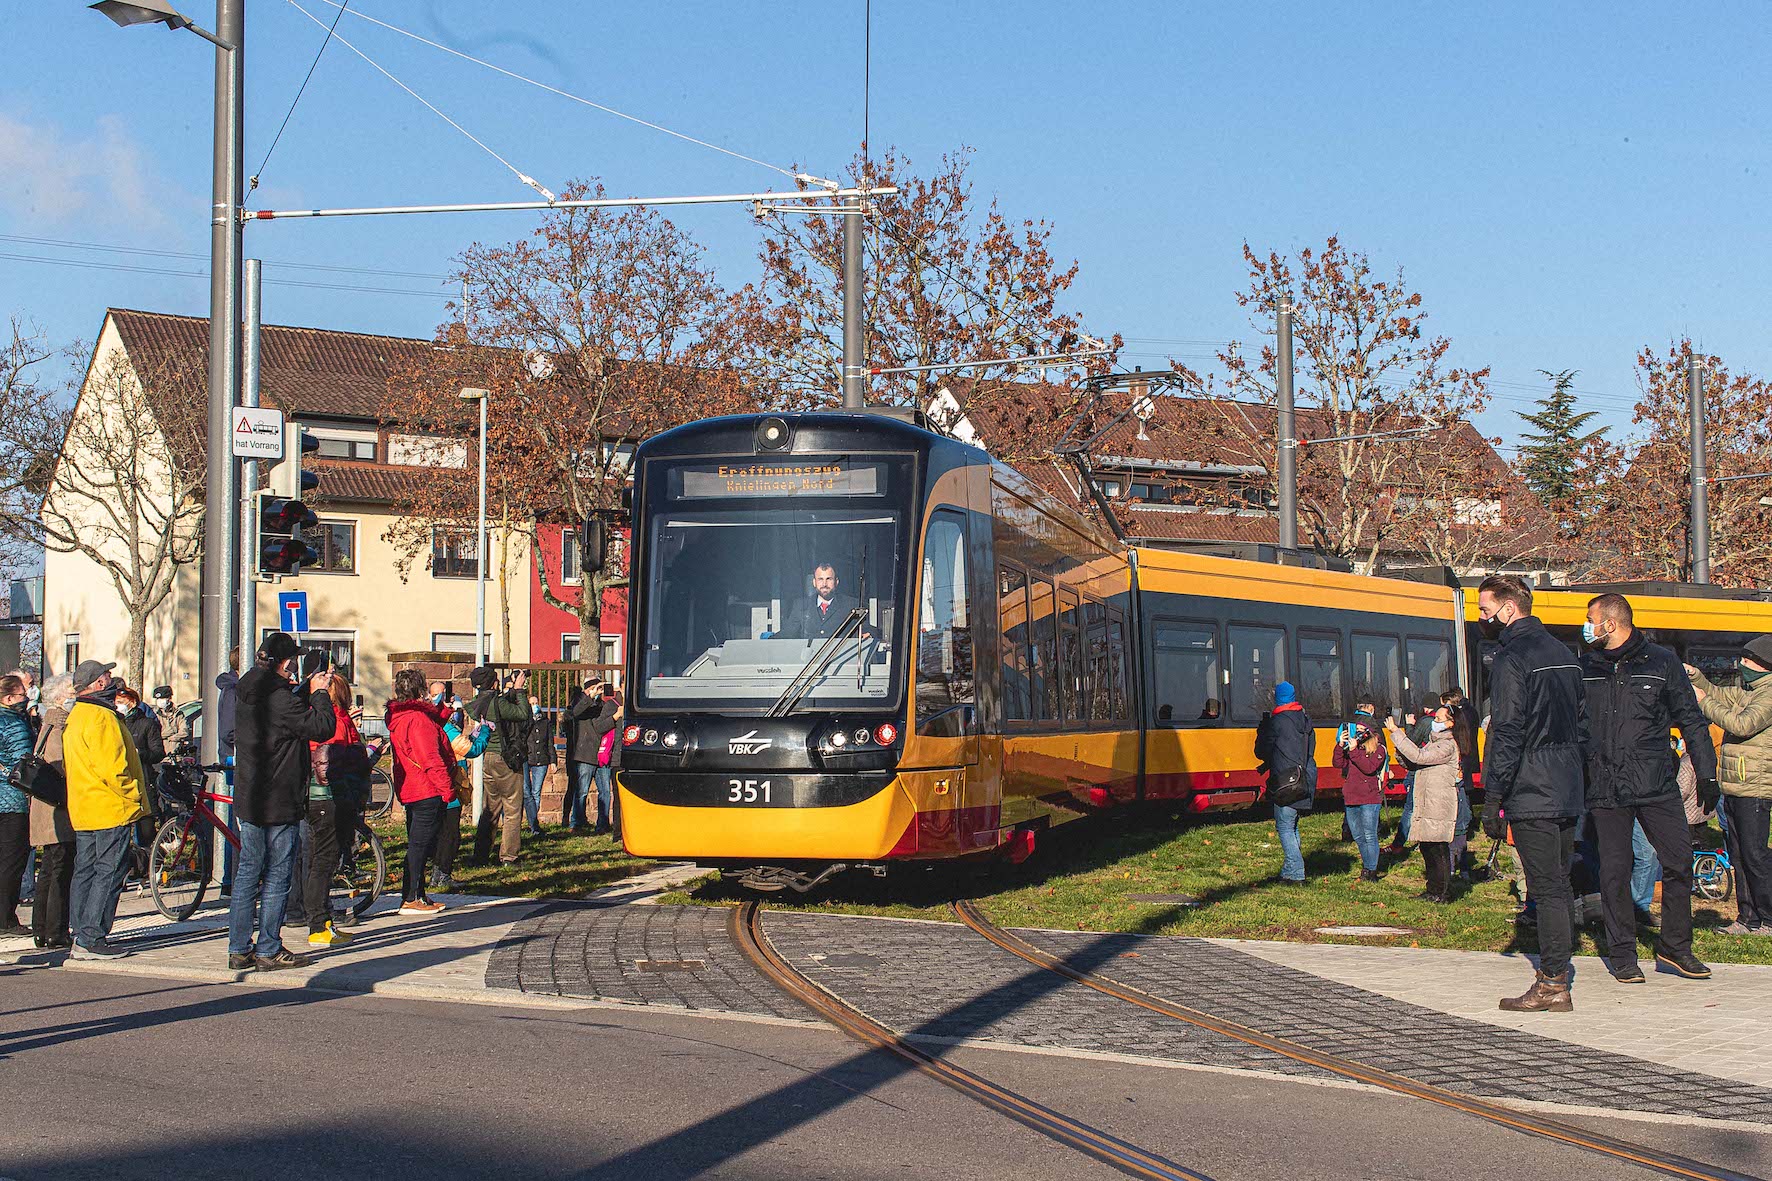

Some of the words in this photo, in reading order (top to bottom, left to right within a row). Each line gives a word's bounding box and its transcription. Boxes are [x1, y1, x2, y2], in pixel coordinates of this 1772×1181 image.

[235, 440, 248, 448] hat
[250, 440, 280, 452] Vorrang
[802, 478, 834, 490] Nord
[728, 743, 754, 755] VBK
[728, 779, 772, 803] 351
